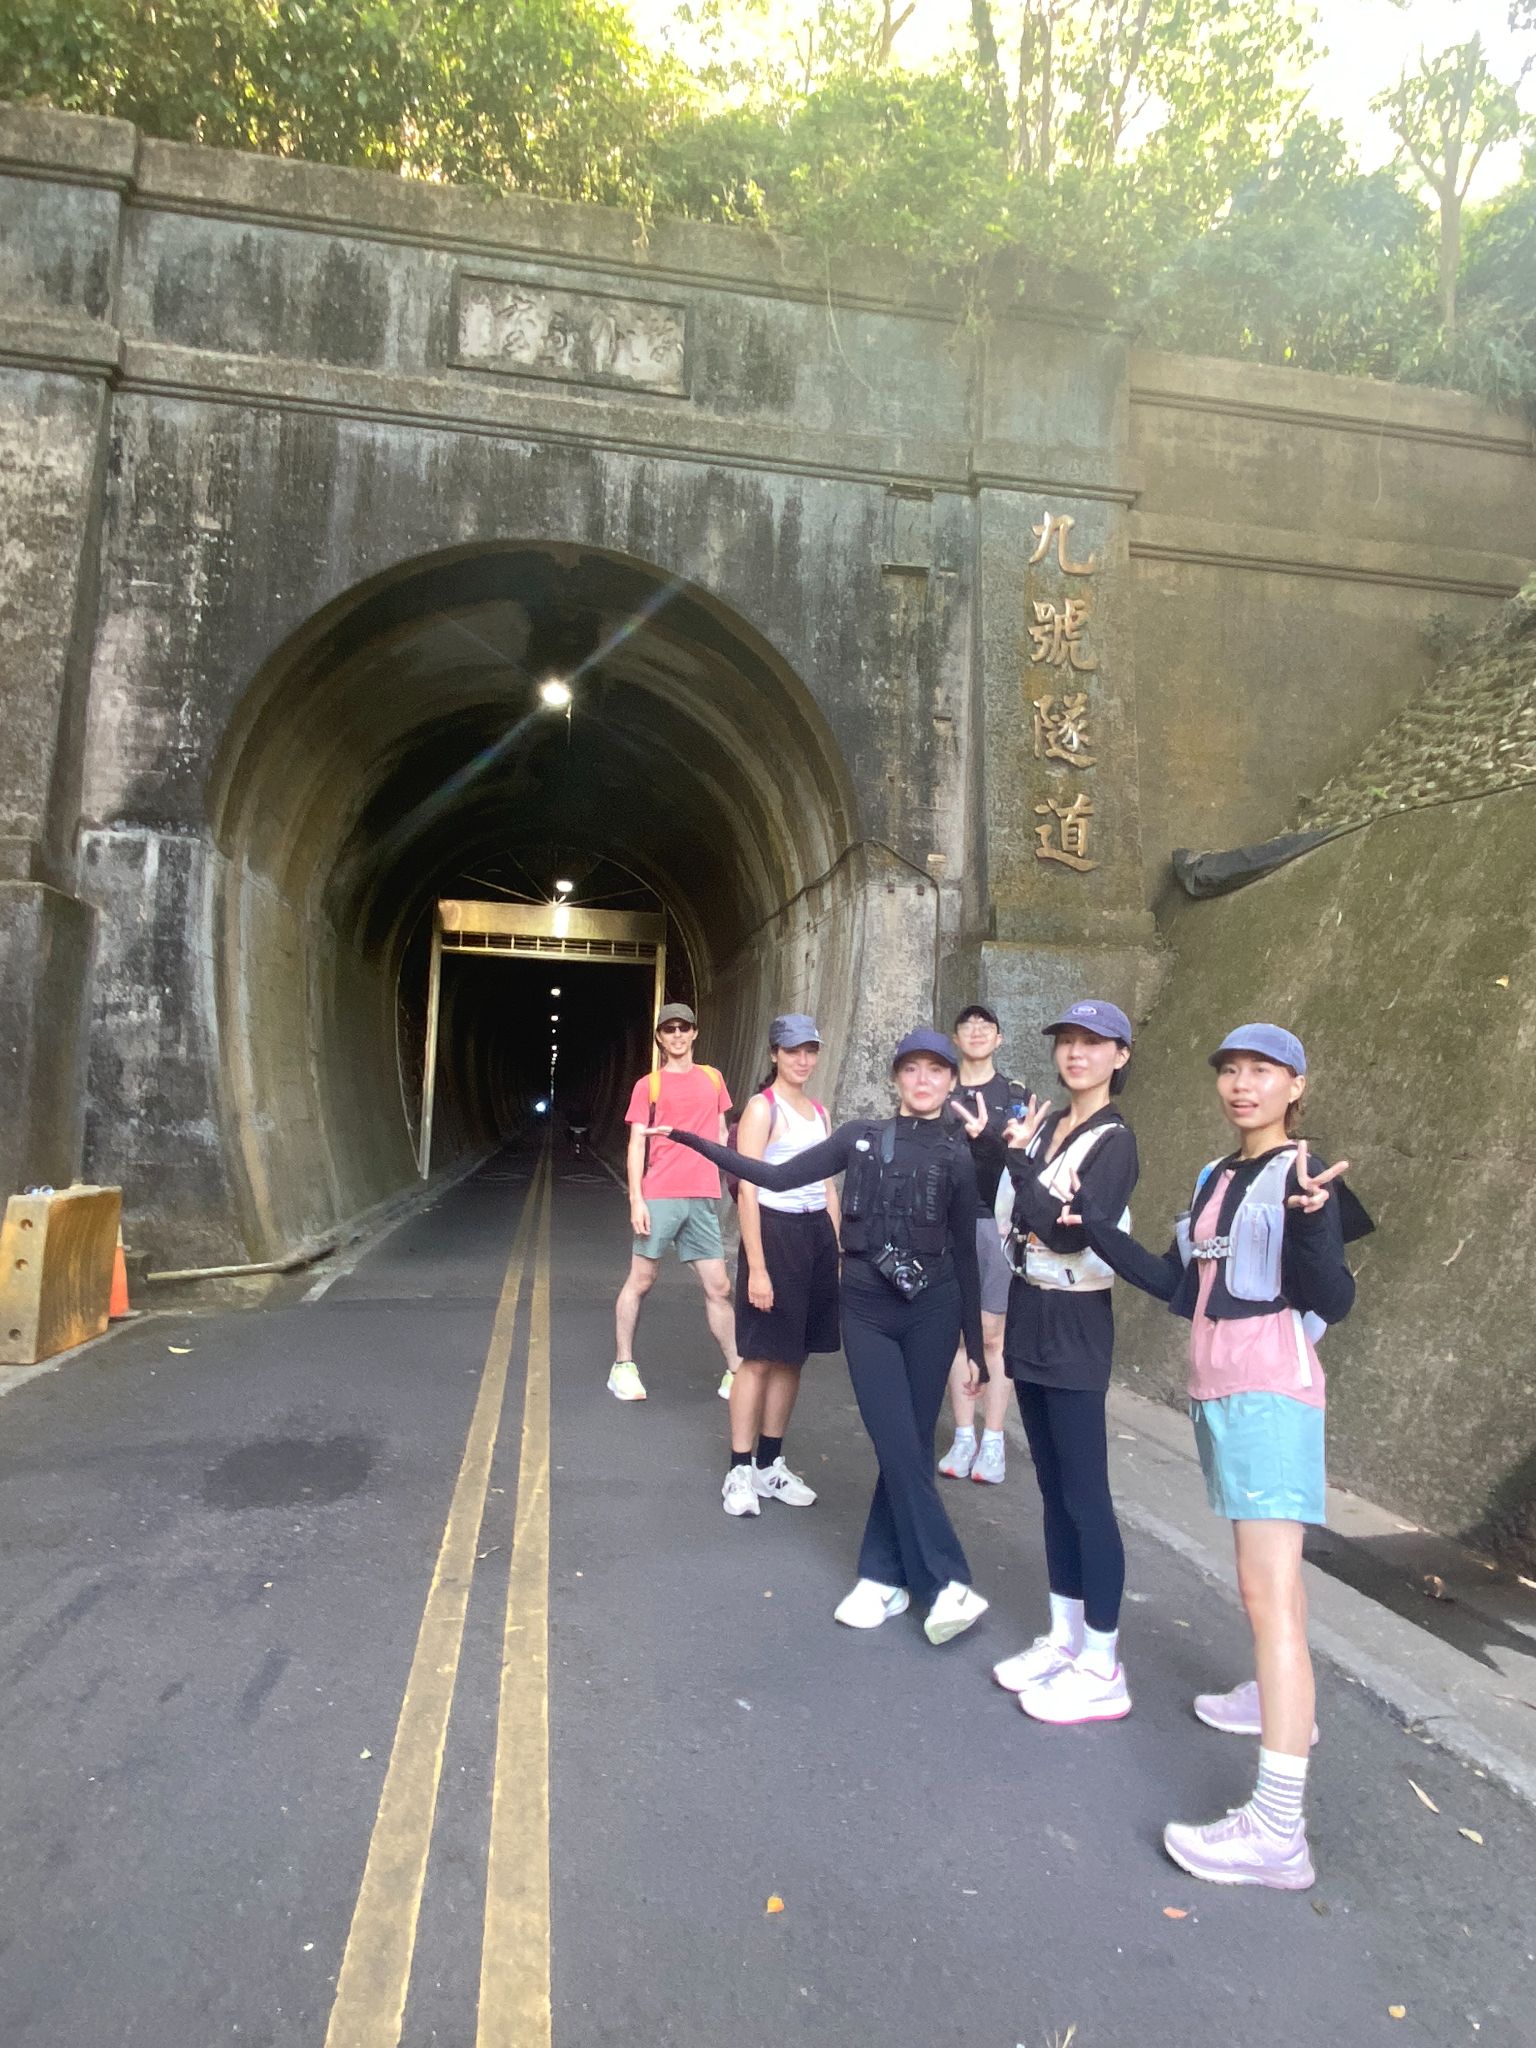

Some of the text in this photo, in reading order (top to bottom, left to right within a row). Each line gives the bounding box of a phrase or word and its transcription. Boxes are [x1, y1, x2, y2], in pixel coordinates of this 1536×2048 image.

[1028, 511, 1099, 873] 九號隧道
[926, 1164, 941, 1221] KIPRUN
